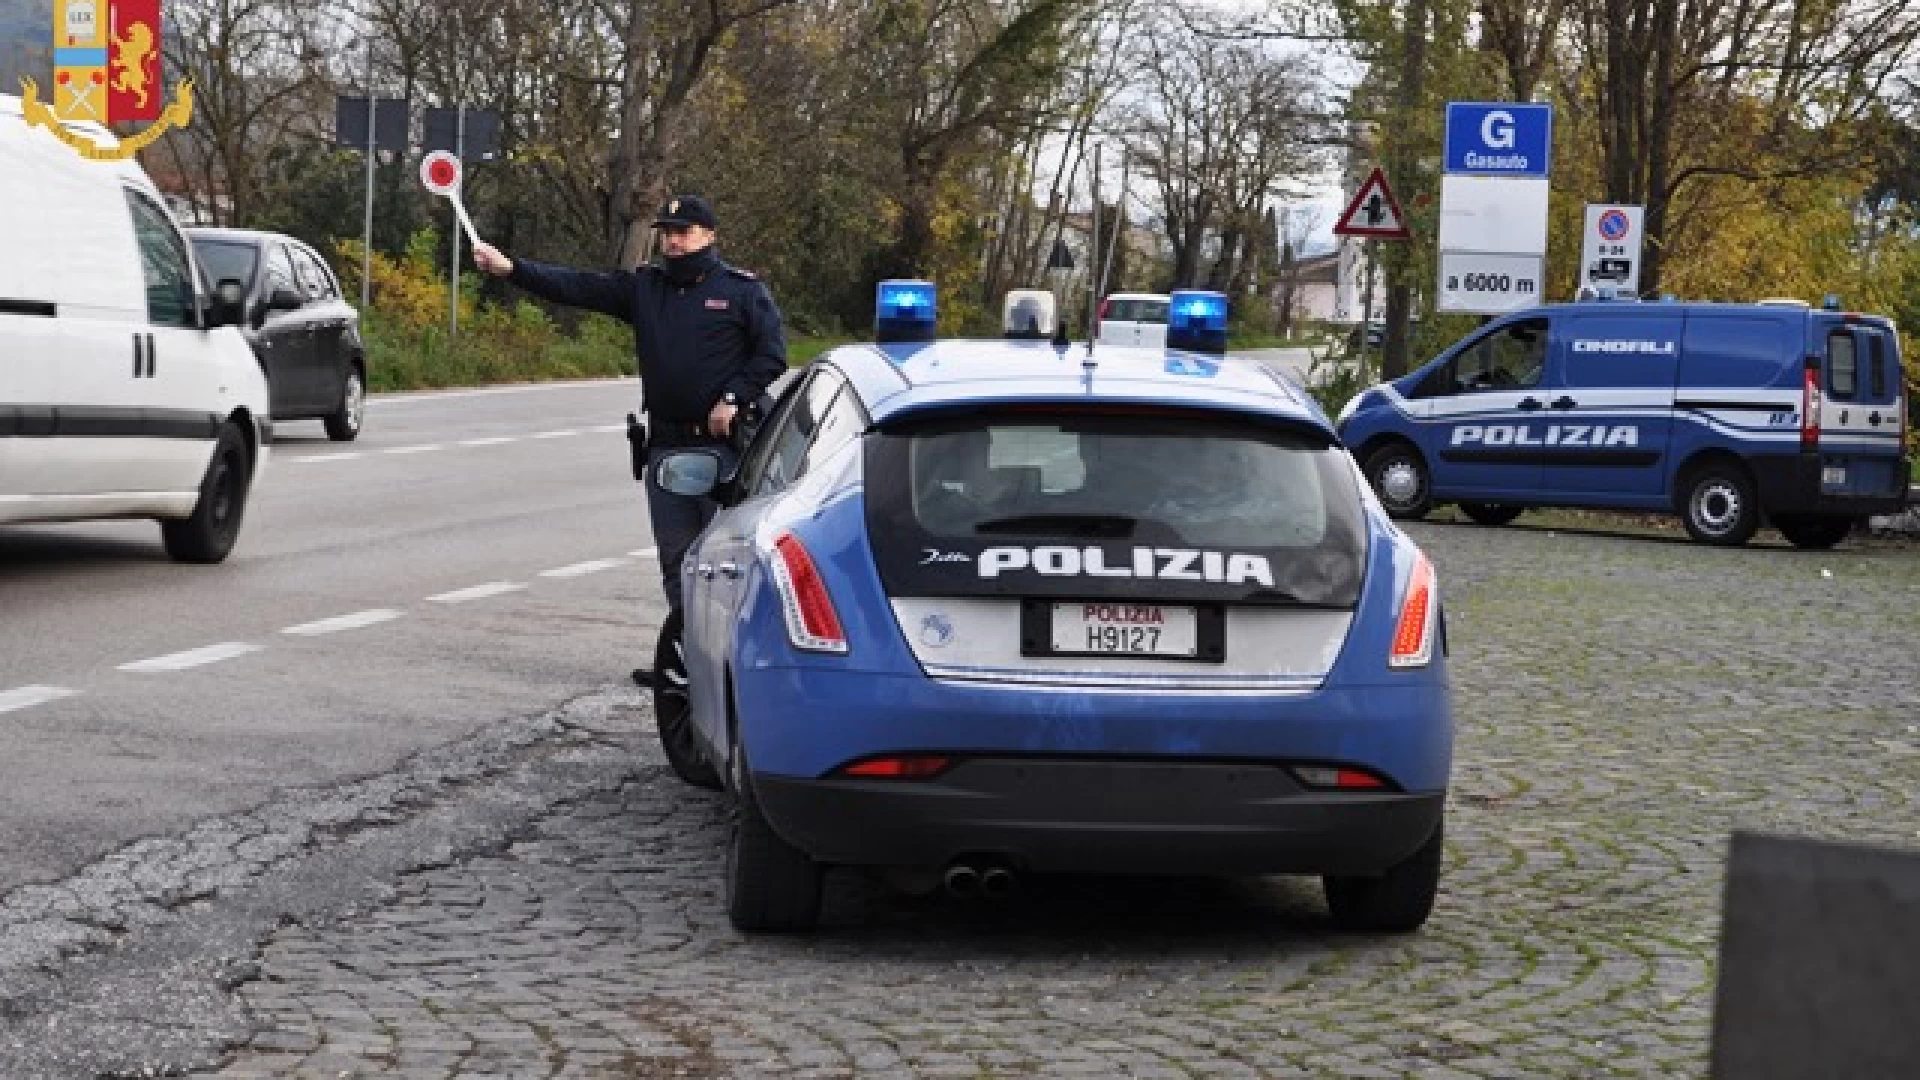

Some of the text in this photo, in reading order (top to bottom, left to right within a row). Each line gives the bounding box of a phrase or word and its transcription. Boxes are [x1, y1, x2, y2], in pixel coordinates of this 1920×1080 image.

[1481, 110, 1515, 148] G
[1446, 273, 1535, 293] a 6000 m
[1451, 425, 1639, 447] POLIZIA
[978, 546, 1275, 587] POLIZIA
[1082, 604, 1165, 625] POLIZIA
[1086, 624, 1162, 653] H9127
